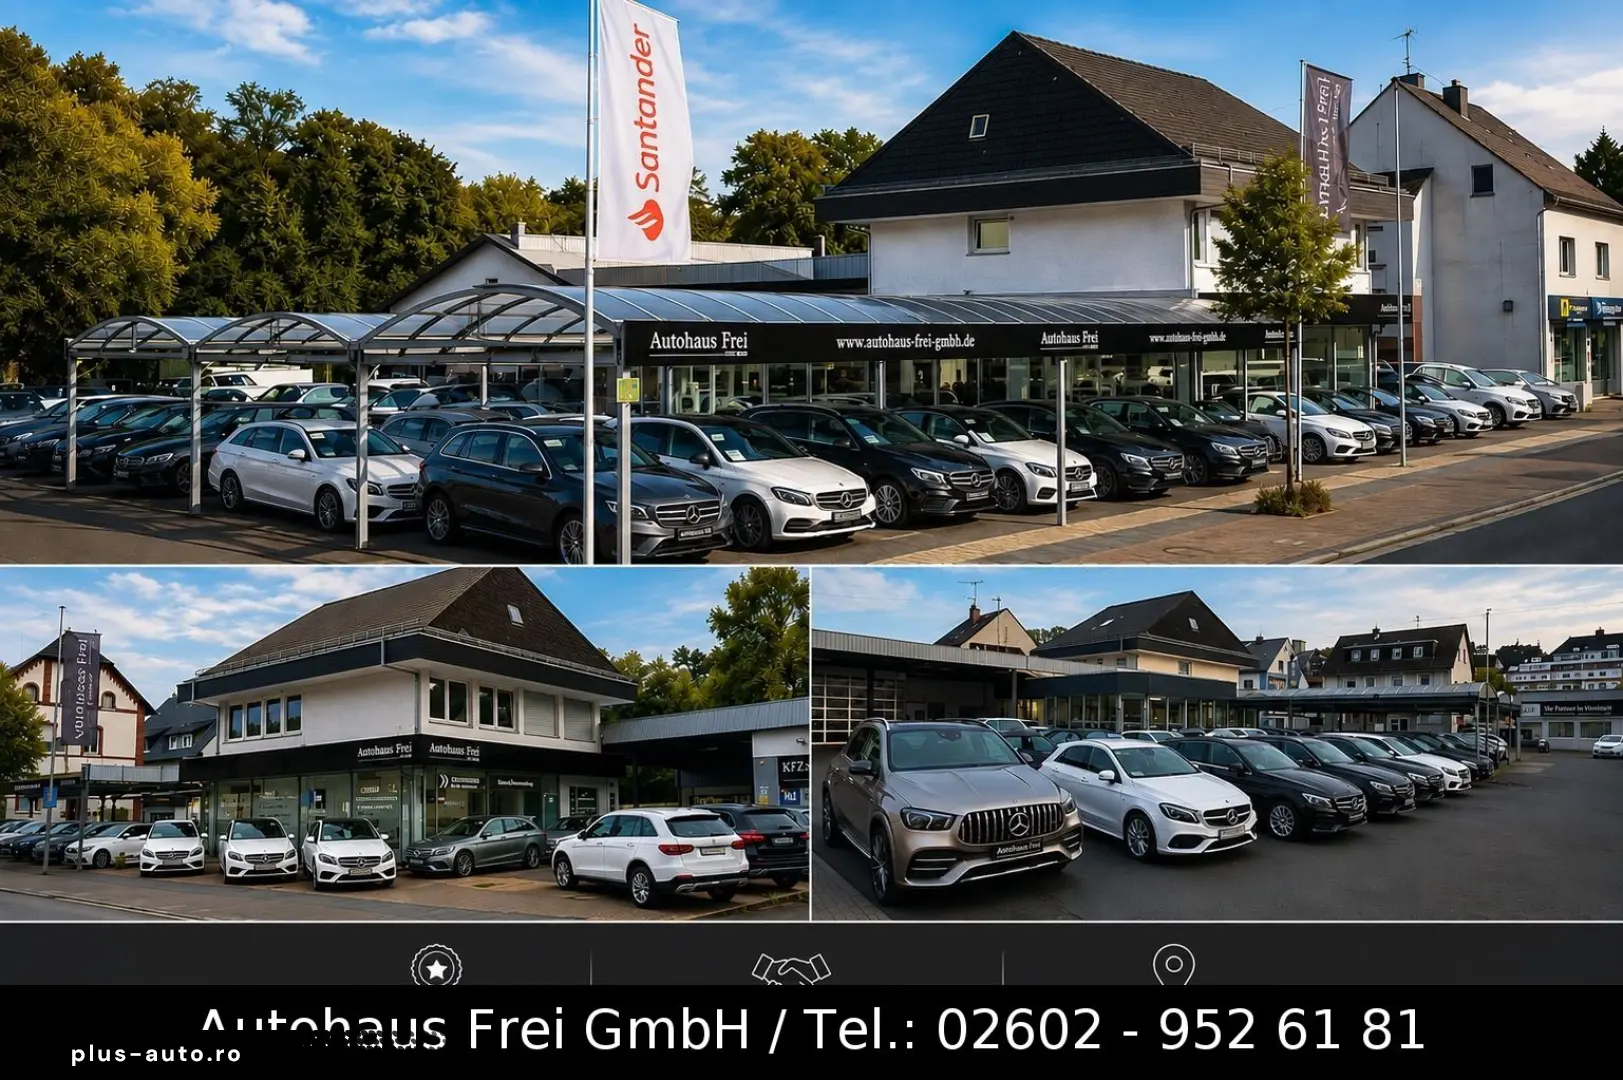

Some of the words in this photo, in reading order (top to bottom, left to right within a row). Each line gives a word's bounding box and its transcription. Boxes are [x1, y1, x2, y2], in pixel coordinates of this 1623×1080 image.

[629, 23, 660, 193] Santander
[649, 331, 718, 349] Autohaus
[721, 331, 748, 349] Frei
[1040, 331, 1081, 344] Autohaus
[1082, 330, 1099, 344] Frei
[357, 745, 394, 758] Autohaus
[395, 741, 413, 754] Frei
[429, 742, 465, 756] Autohaus
